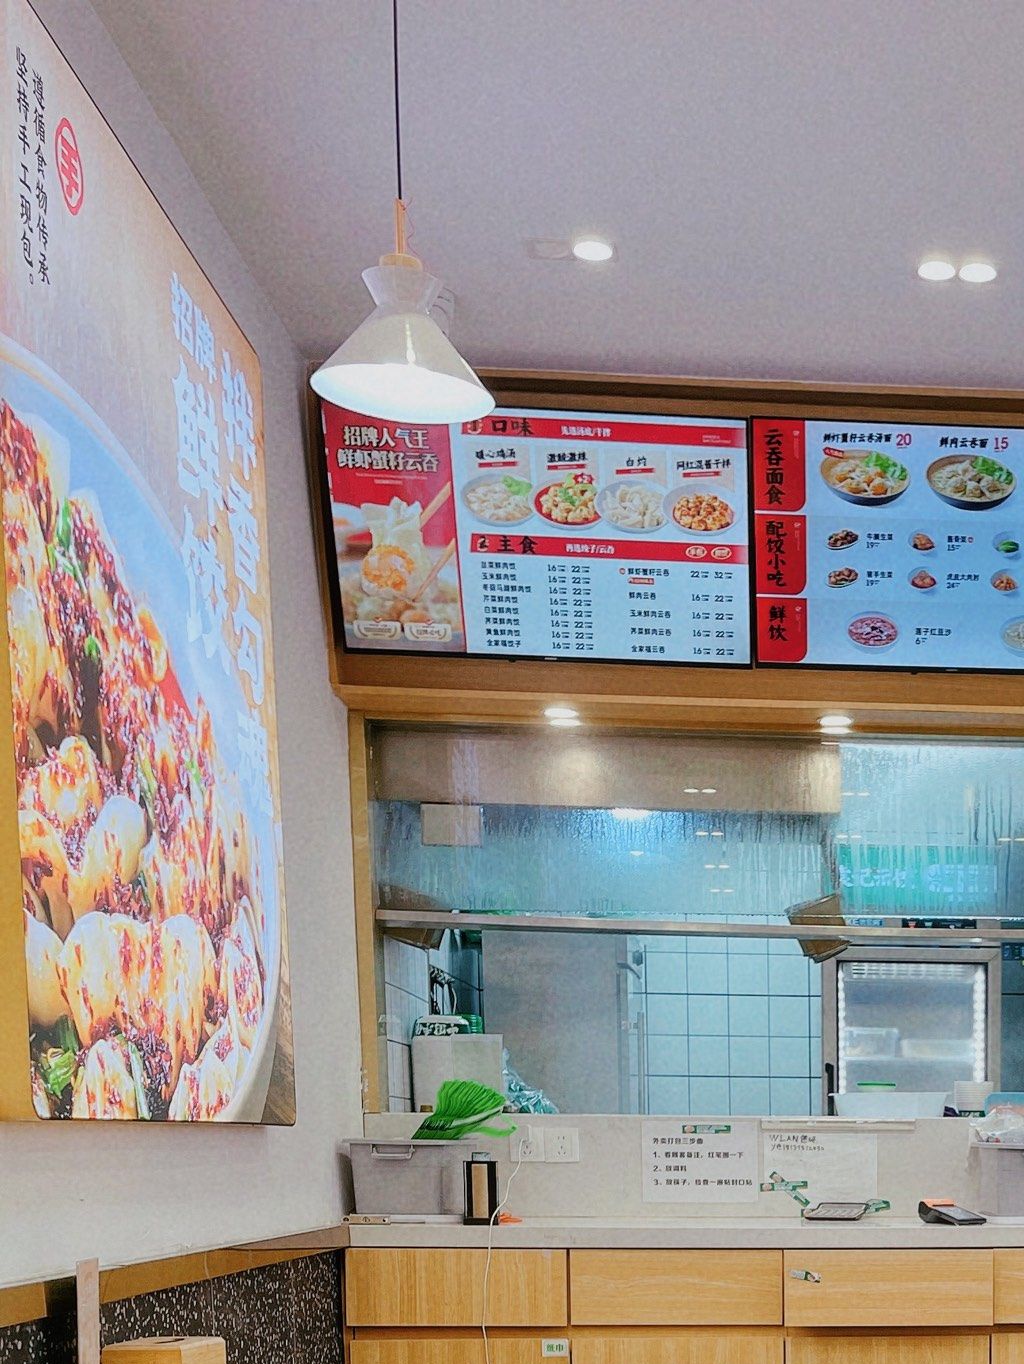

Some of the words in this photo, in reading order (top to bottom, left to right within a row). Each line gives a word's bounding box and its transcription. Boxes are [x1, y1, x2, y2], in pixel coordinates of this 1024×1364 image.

[343, 425, 430, 449] 招牌人气王
[491, 417, 533, 436] 口味
[896, 433, 912, 447] 20
[994, 437, 1009, 450] 15
[764, 429, 785, 505] 云吞面食
[496, 535, 538, 555] 主食
[766, 521, 787, 587] 配饺小吃
[768, 605, 788, 642] 鲜饮
